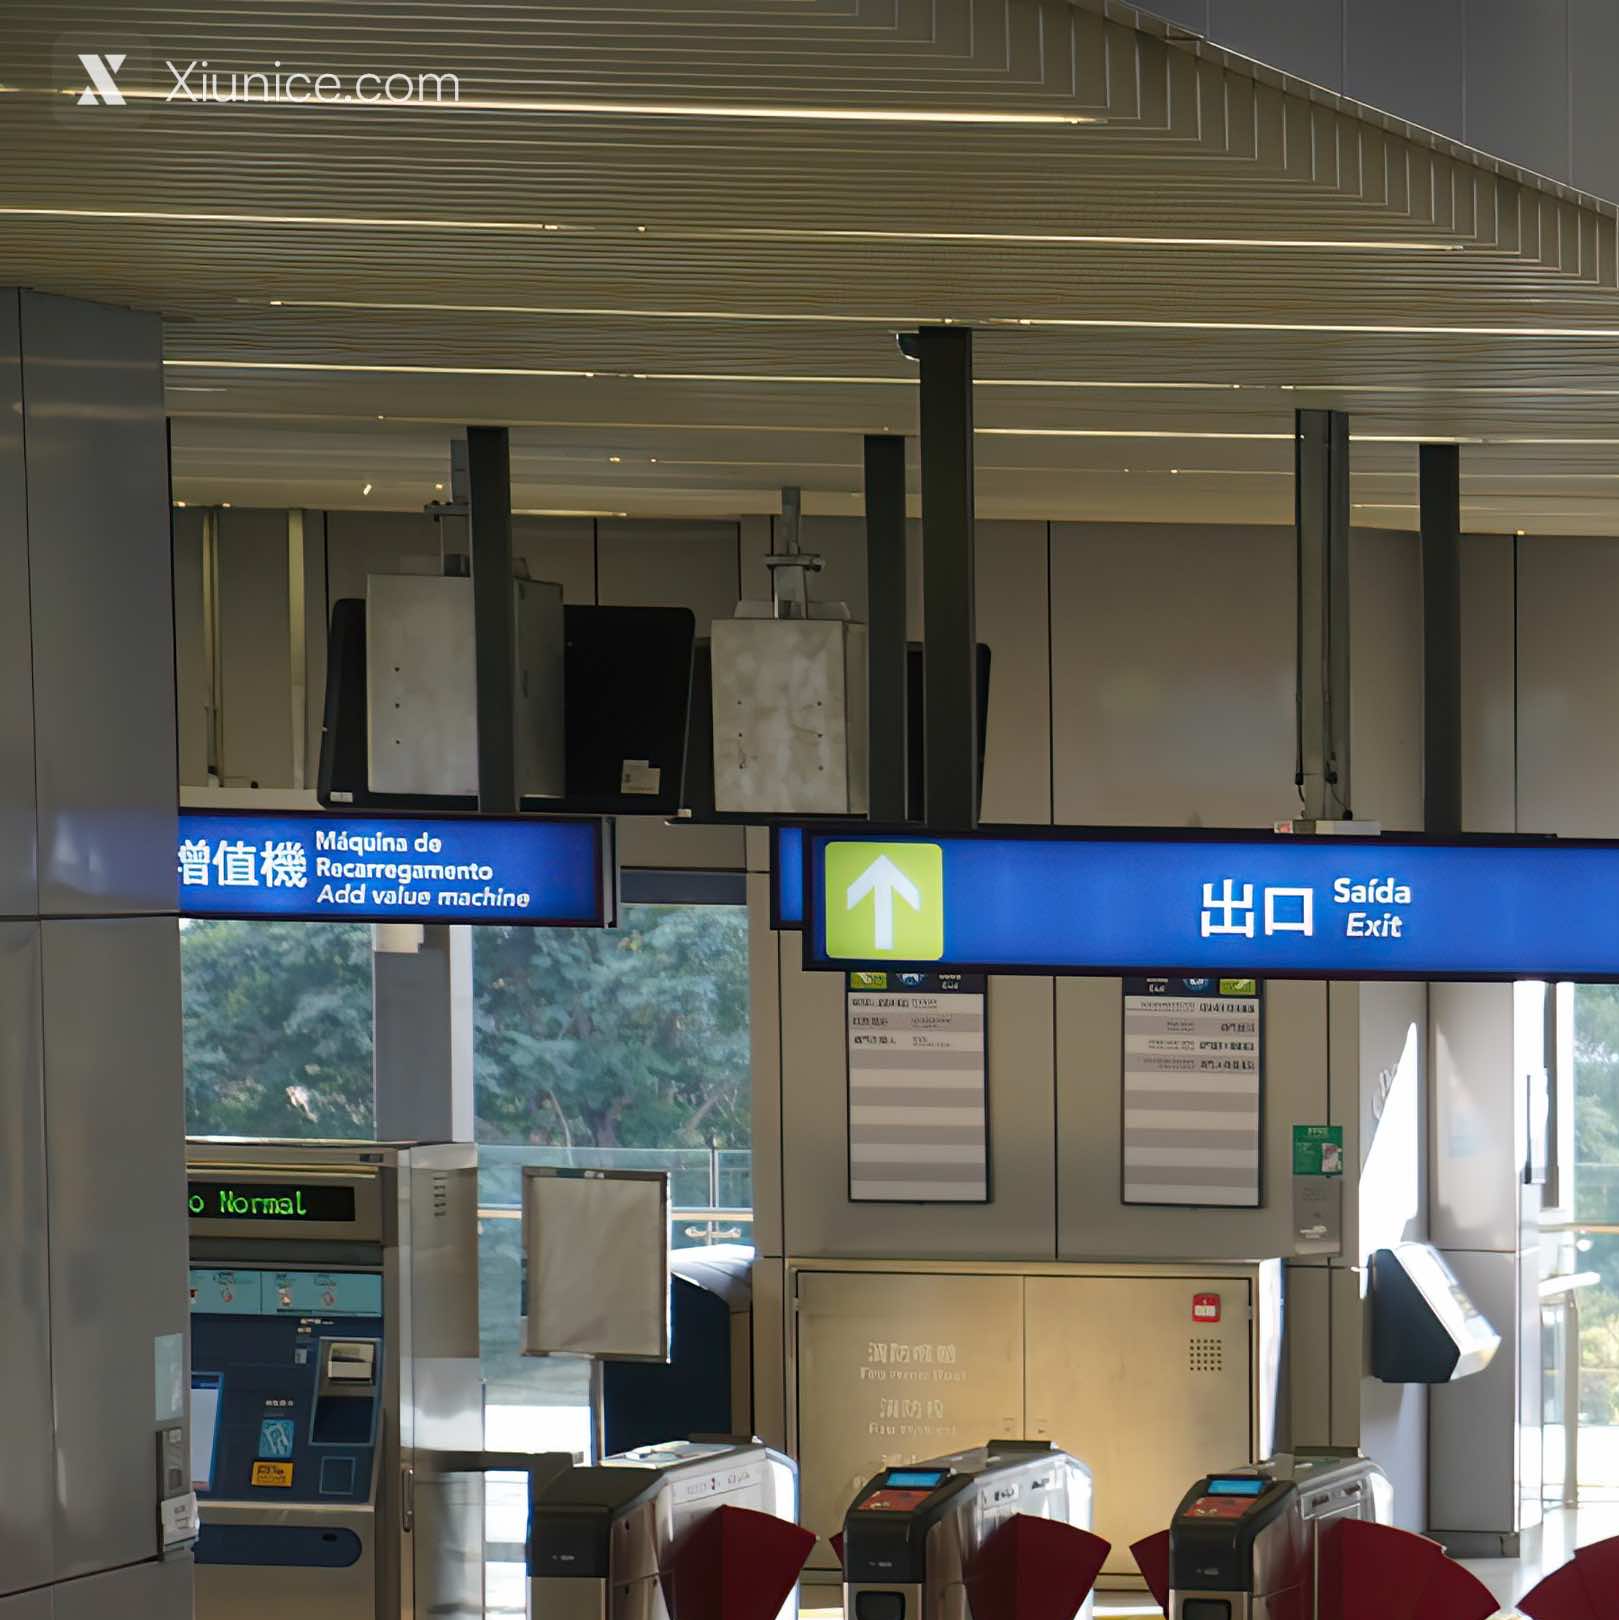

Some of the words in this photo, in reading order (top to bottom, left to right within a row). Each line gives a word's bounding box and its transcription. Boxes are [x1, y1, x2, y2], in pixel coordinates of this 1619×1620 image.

[315, 830, 408, 854] Máquina
[414, 831, 442, 853] de
[315, 857, 494, 884] Recarregamento
[316, 883, 366, 905] Add
[372, 886, 431, 906] value
[437, 887, 531, 908] machine
[1333, 877, 1412, 904] Saída
[1200, 878, 1314, 938] 出口
[1346, 911, 1403, 938] Exit
[220, 1189, 307, 1215] Normal
